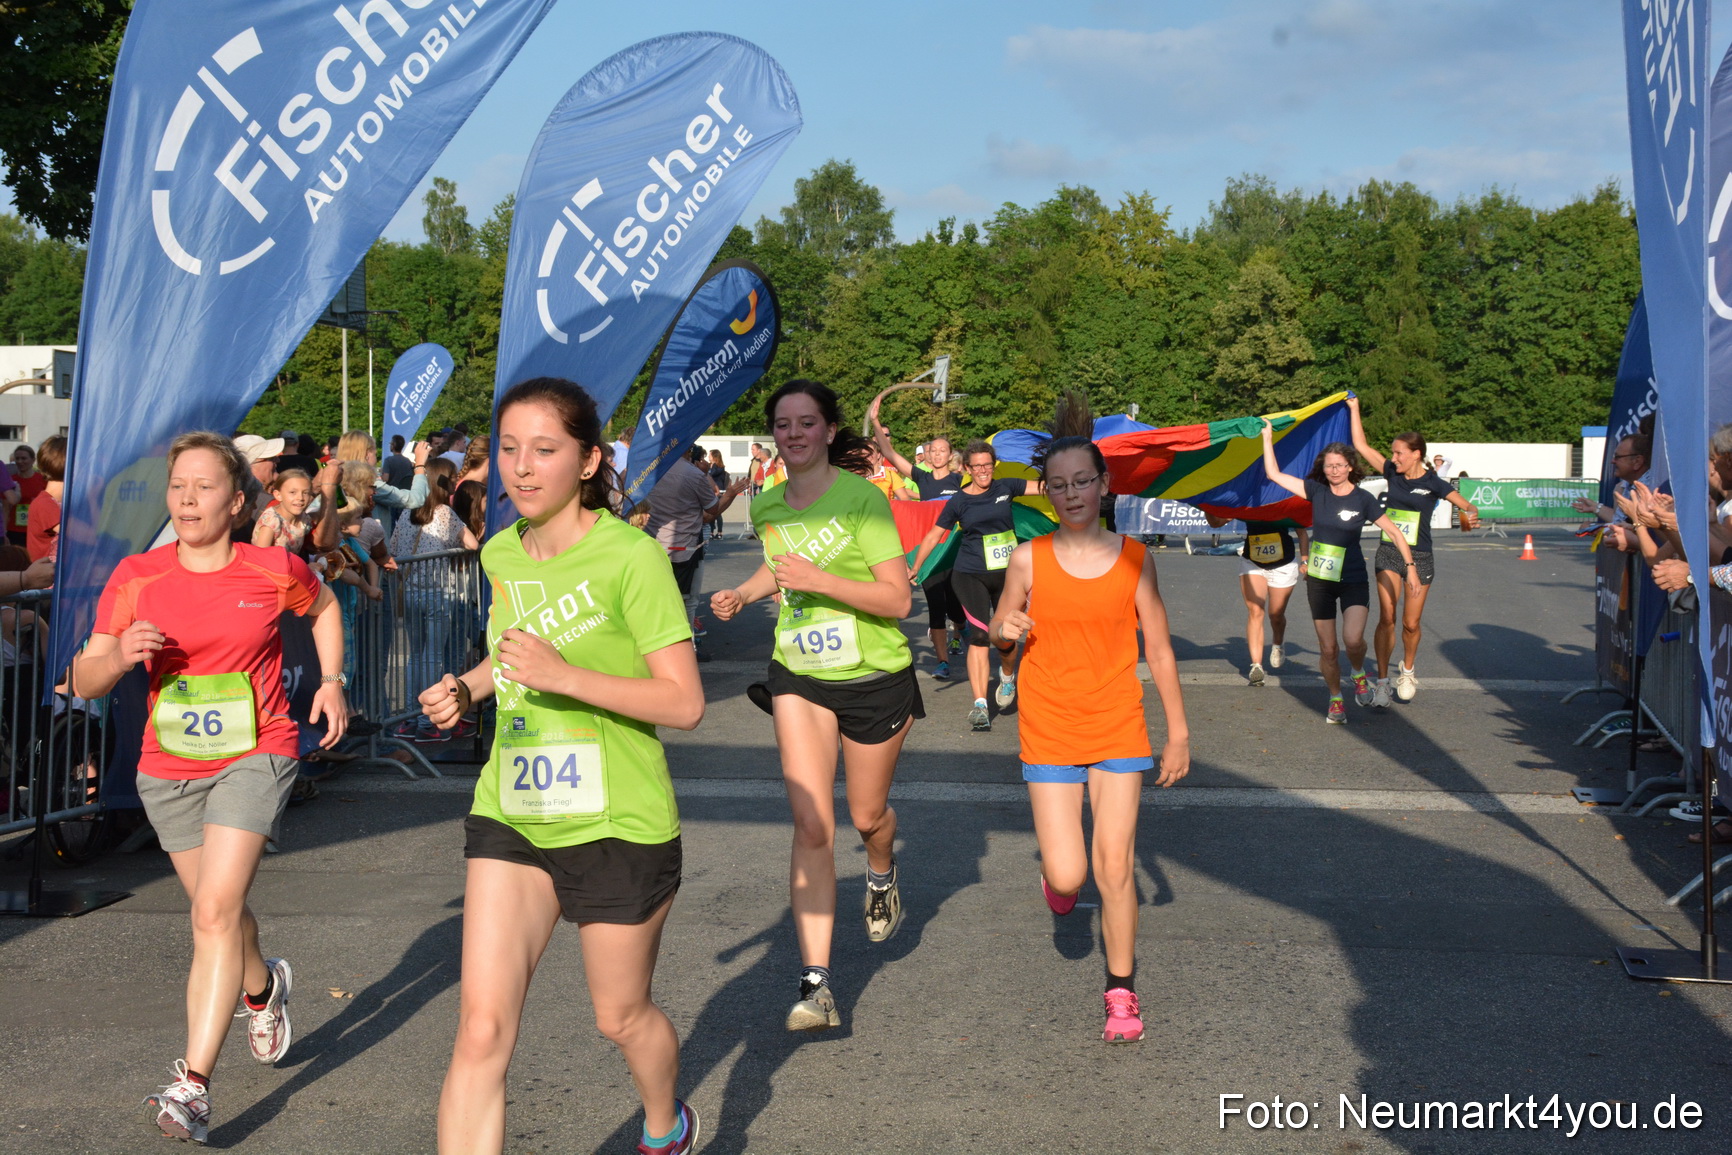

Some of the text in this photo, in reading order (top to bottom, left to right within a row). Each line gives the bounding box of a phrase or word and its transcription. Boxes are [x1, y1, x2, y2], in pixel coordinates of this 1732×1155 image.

[213, 0, 437, 224] Fisch
[303, 0, 490, 224] AUTOMOBIL
[574, 82, 733, 306] Fischer
[630, 124, 753, 303] AUTOMOBILE
[705, 370, 728, 396] Druck
[743, 328, 772, 362] Medien
[400, 356, 439, 415] Fischer
[413, 367, 443, 414] AUTOMOBILE
[645, 338, 739, 437] Frischmann
[1469, 485, 1504, 505] AOK
[1395, 523, 1410, 535] 74
[992, 545, 1014, 559] 689
[1255, 545, 1276, 556] 748
[1313, 556, 1334, 571] 673
[792, 627, 842, 655] 195
[181, 710, 223, 737] 26
[513, 753, 581, 791] 204
